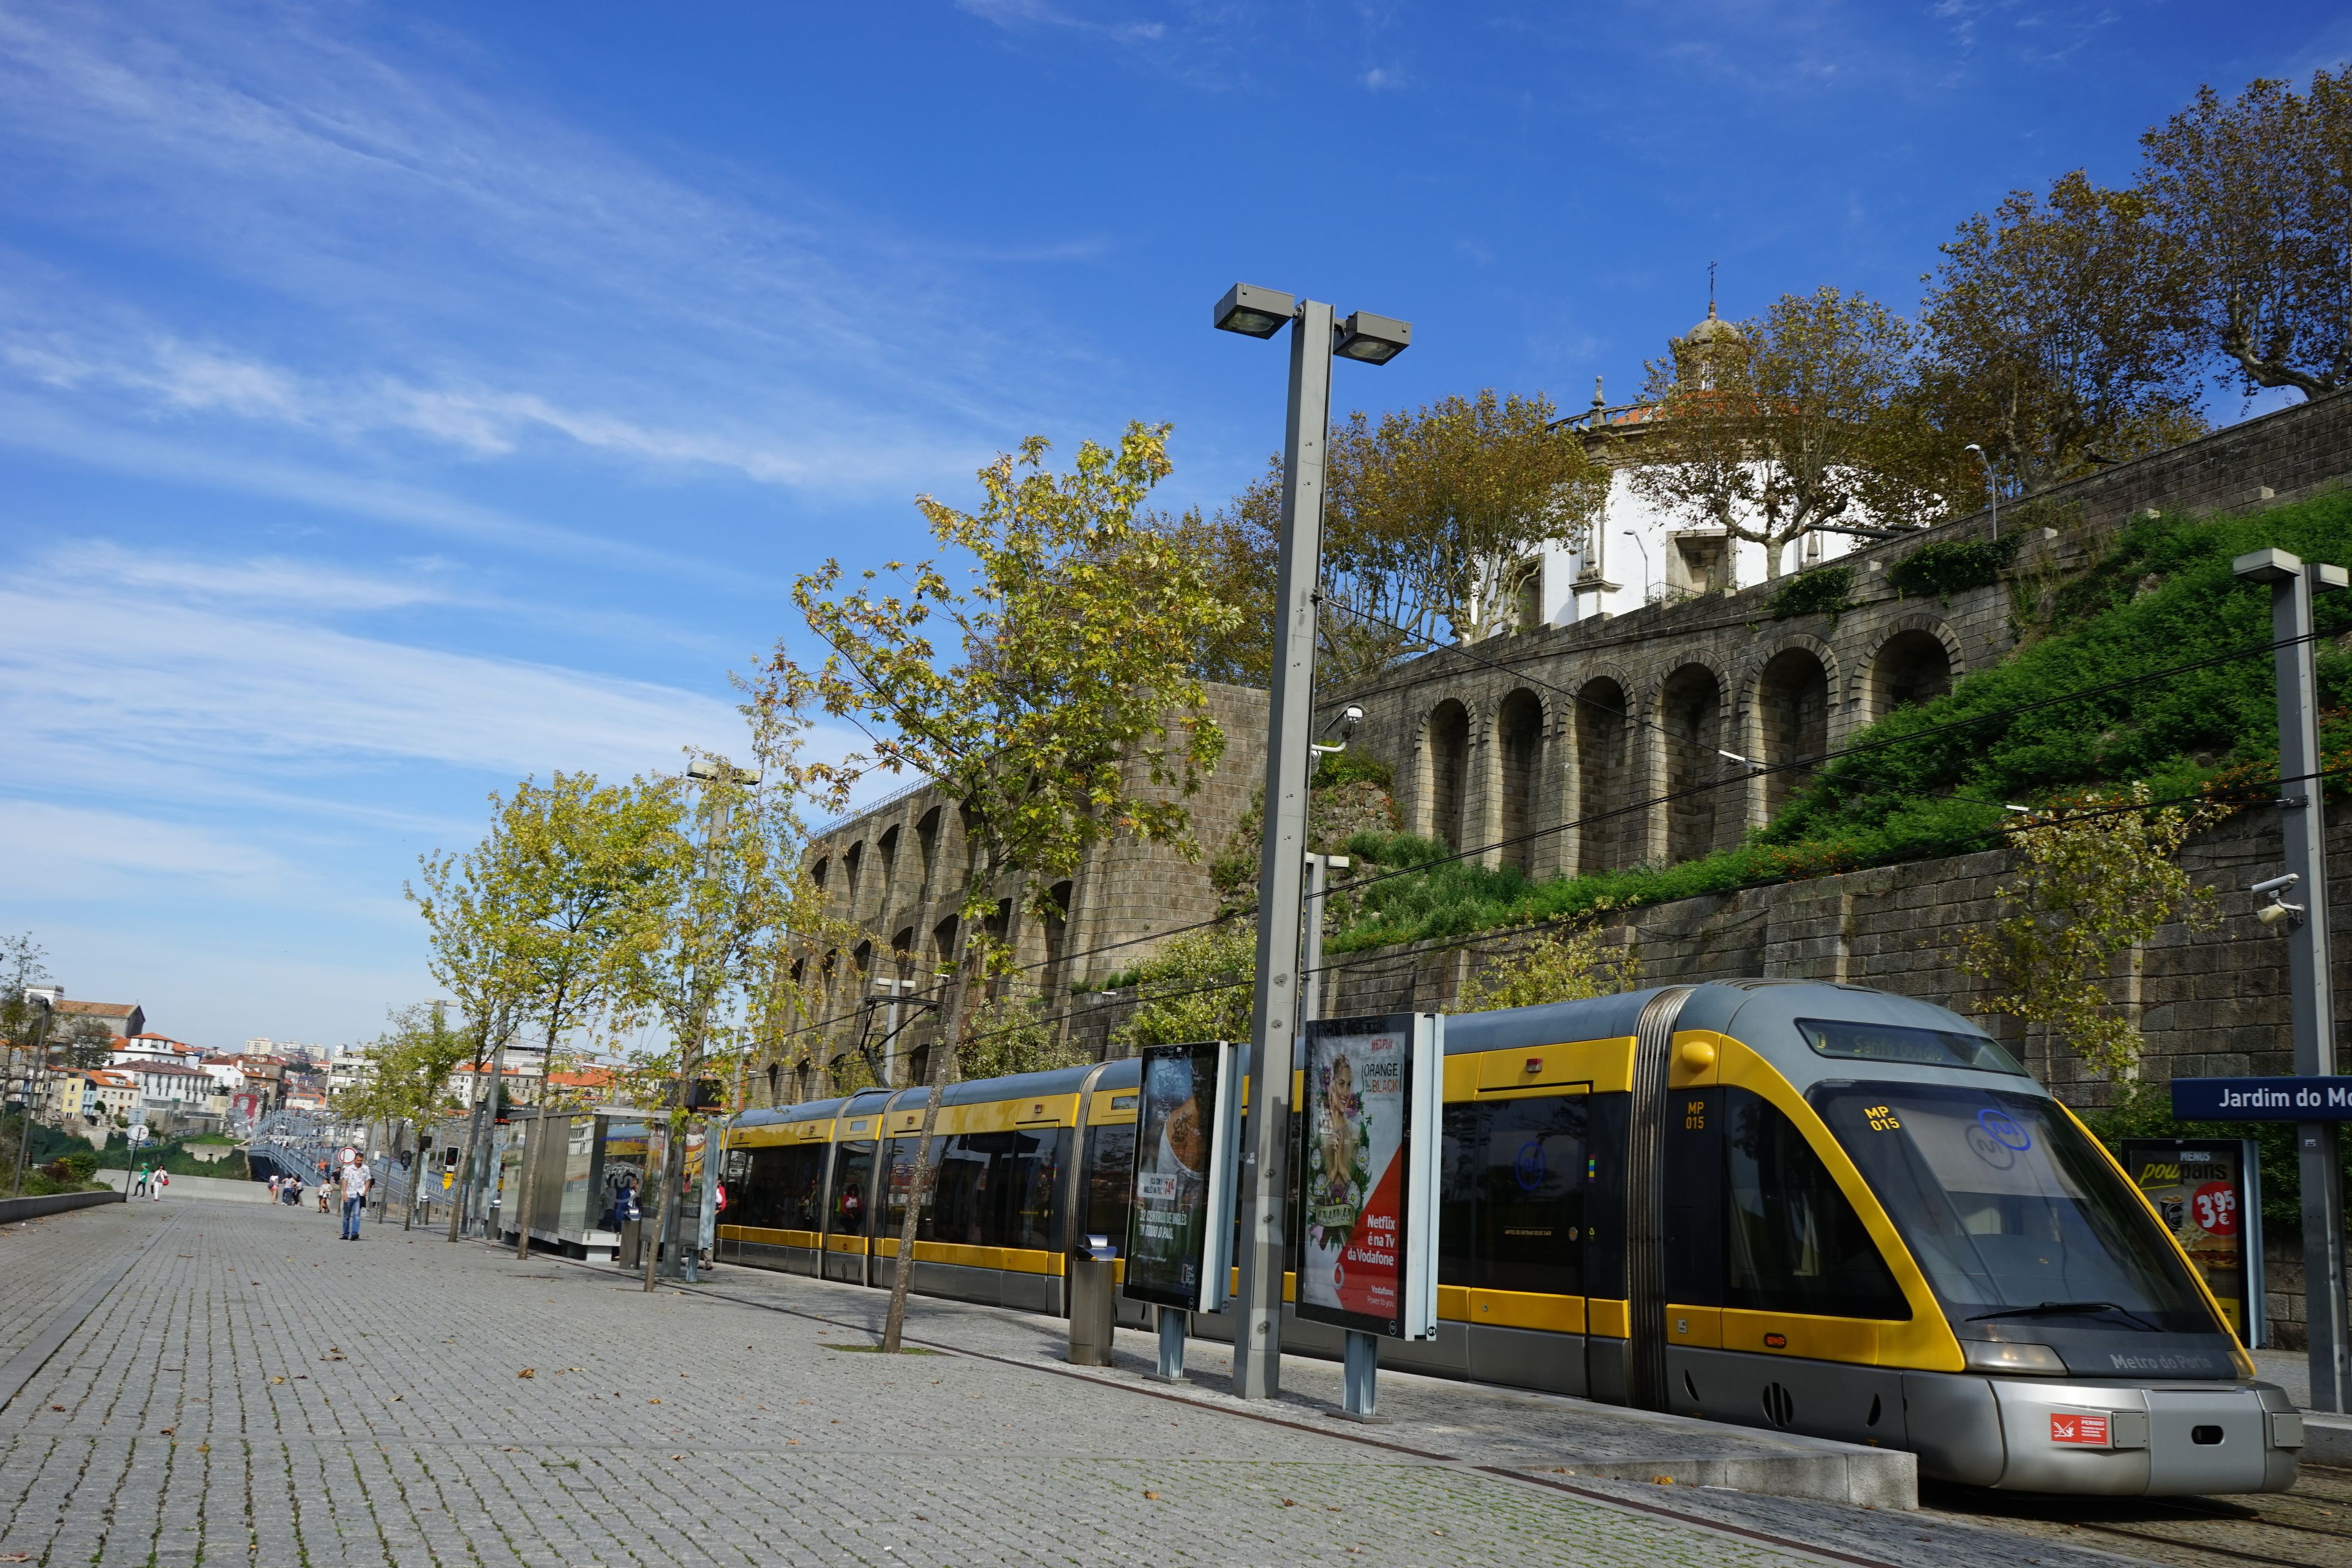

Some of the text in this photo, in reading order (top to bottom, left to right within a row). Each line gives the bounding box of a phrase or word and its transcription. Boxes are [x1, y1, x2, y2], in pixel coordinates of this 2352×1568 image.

[1371, 1038, 1393, 1050] NETFLIX
[1854, 1036, 1895, 1056] Santo
[1364, 1063, 1398, 1077] ORANGE
[1372, 1079, 1398, 1093] BLACK
[2219, 1088, 2290, 1107] Jardim
[2296, 1088, 2321, 1107] do
[1688, 1101, 1704, 1114] MP
[1864, 1106, 1890, 1120] MP
[1686, 1116, 1704, 1129] 015
[1870, 1117, 1901, 1131] 015
[2180, 1151, 2211, 1161] MENUS
[1140, 1210, 1187, 1226] 32 CENTROS DE INGLÊS
[1367, 1215, 1395, 1230] Netflix
[1145, 1225, 1158, 1237] TODO
[1158, 1226, 1163, 1238] O
[1368, 1232, 1395, 1248] é na Tv
[1348, 1248, 1394, 1266] da Vodafone
[1371, 1285, 1394, 1296] Vodafone
[1367, 1295, 1381, 1306] Power
[2109, 1354, 2213, 1369] Metro do Porto
